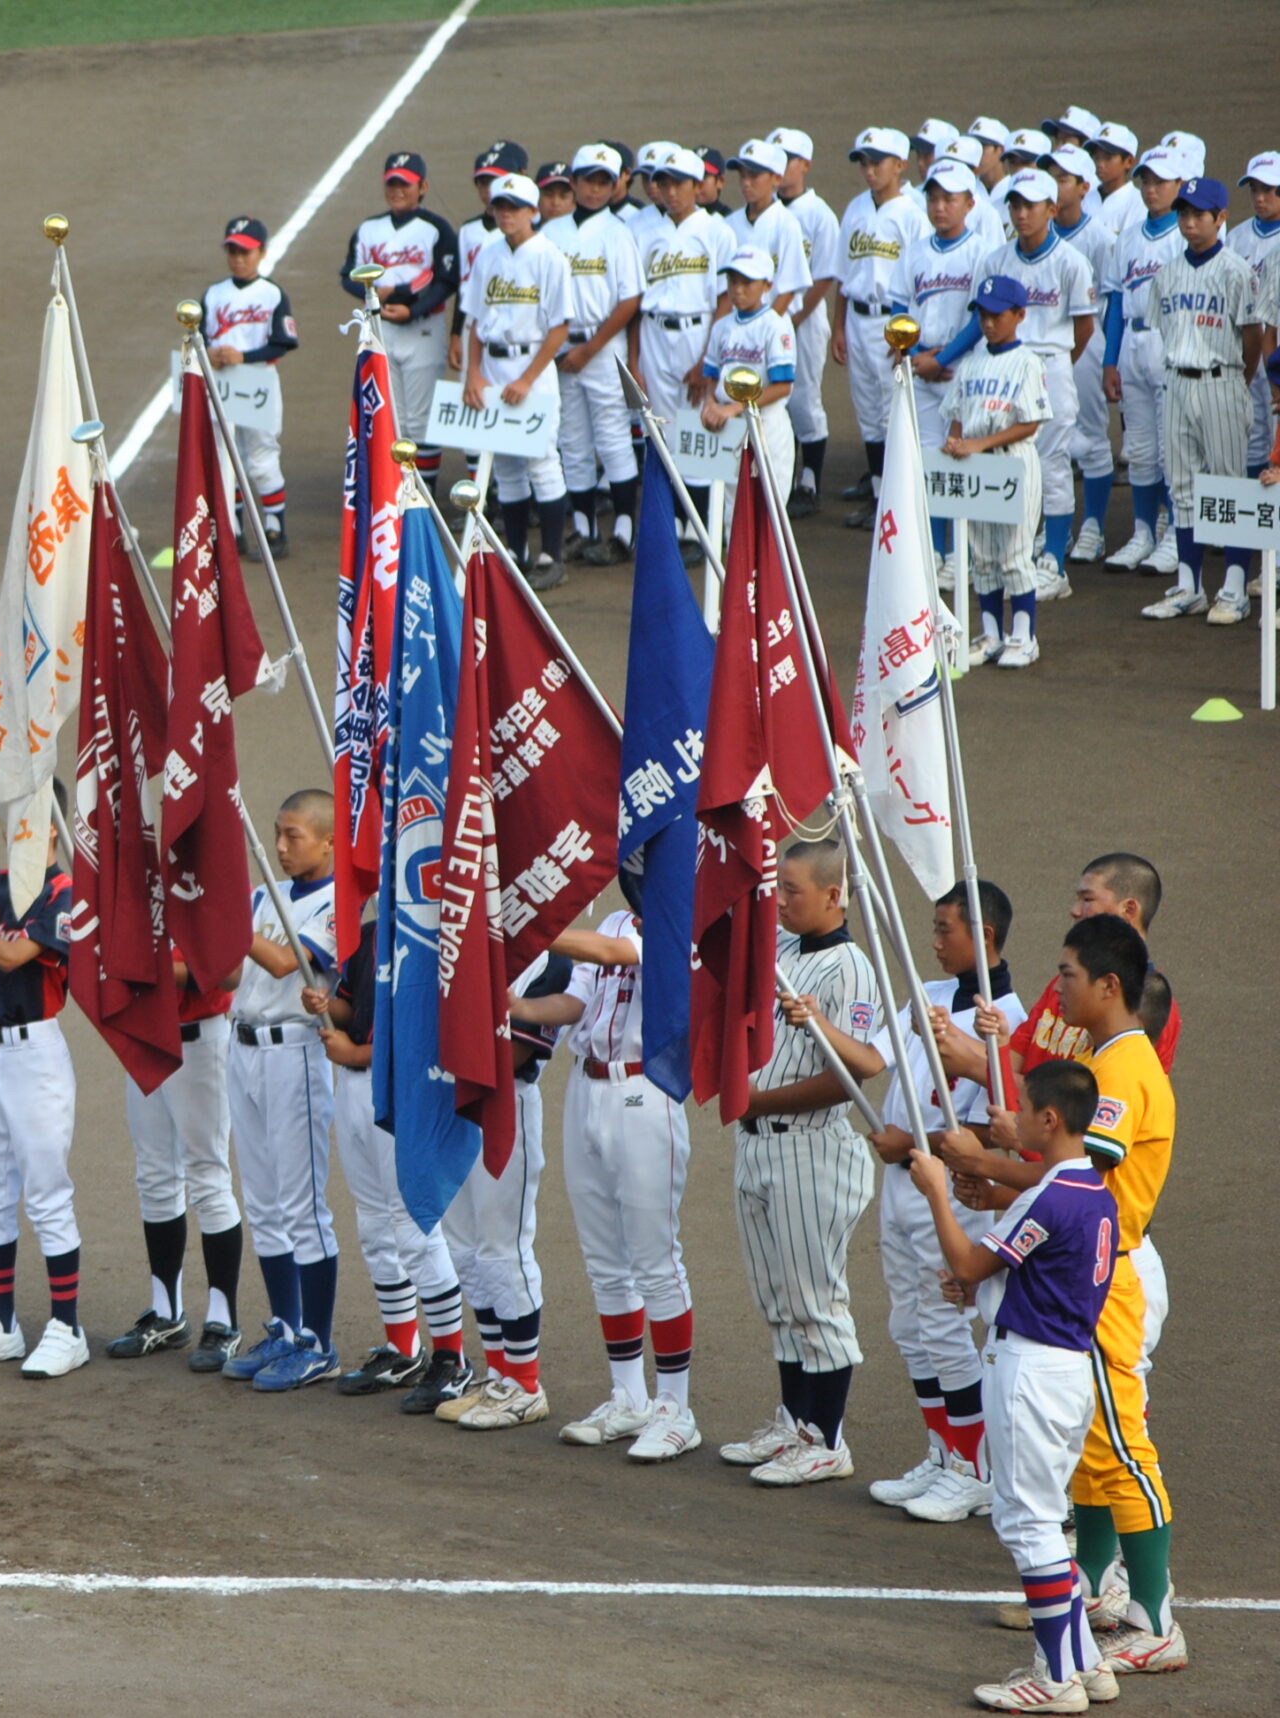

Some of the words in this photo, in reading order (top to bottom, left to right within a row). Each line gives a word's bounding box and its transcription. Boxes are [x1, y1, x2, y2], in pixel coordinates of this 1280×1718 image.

[439, 402, 546, 434] 市川リーグ
[1200, 495, 1280, 529] 尾張一宮
